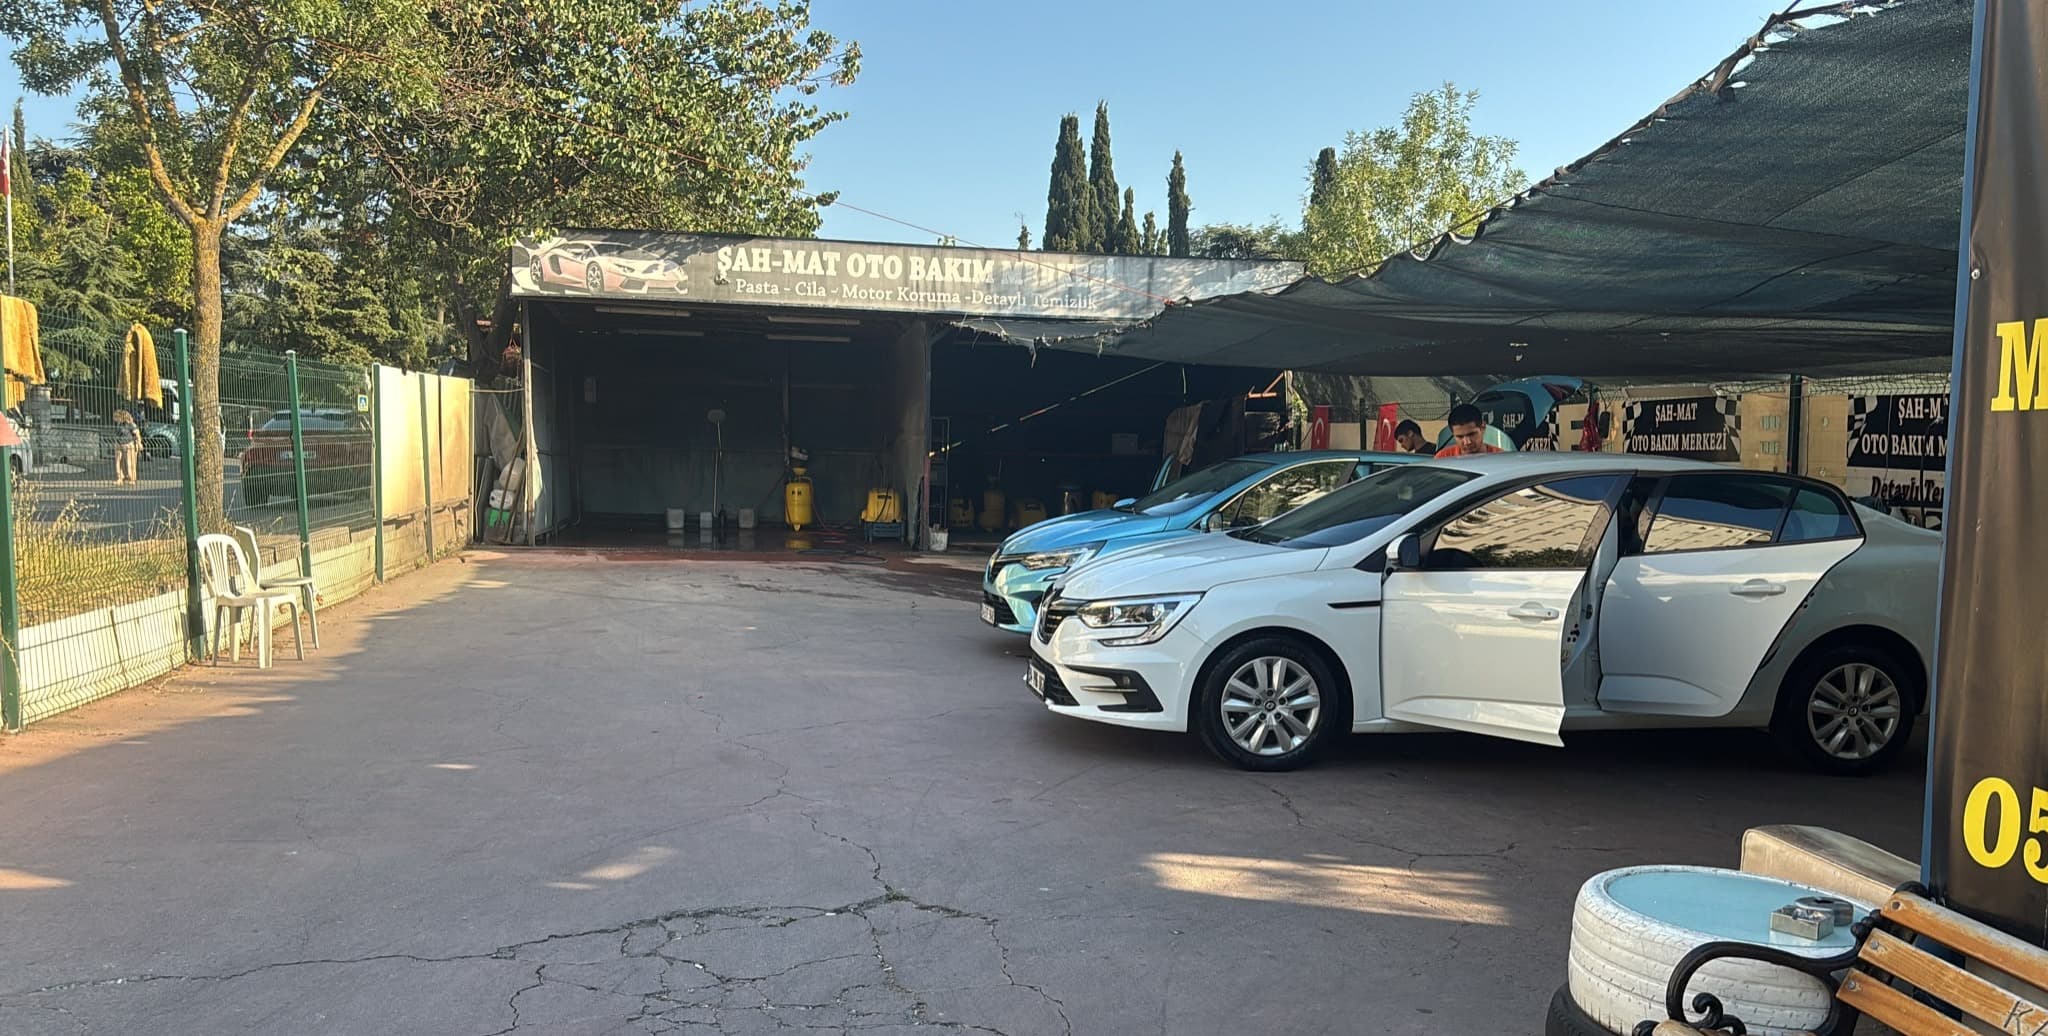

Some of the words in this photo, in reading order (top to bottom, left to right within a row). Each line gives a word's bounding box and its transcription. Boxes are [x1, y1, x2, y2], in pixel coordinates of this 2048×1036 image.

[717, 246, 840, 280] ŞAH-MAT
[846, 253, 903, 280] OTO
[909, 256, 995, 284] BAKIM
[735, 278, 779, 295] Pasta
[795, 281, 826, 297] Cila
[842, 283, 893, 301] Motor
[897, 286, 961, 304] Koruma
[1655, 402, 1698, 428] ŞAH-MAT
[1632, 434, 1649, 452] OTO
[1650, 433, 1680, 452] BAKIM
[1681, 431, 1728, 452] MERKEZİ
[1861, 433, 1889, 455] OTO
